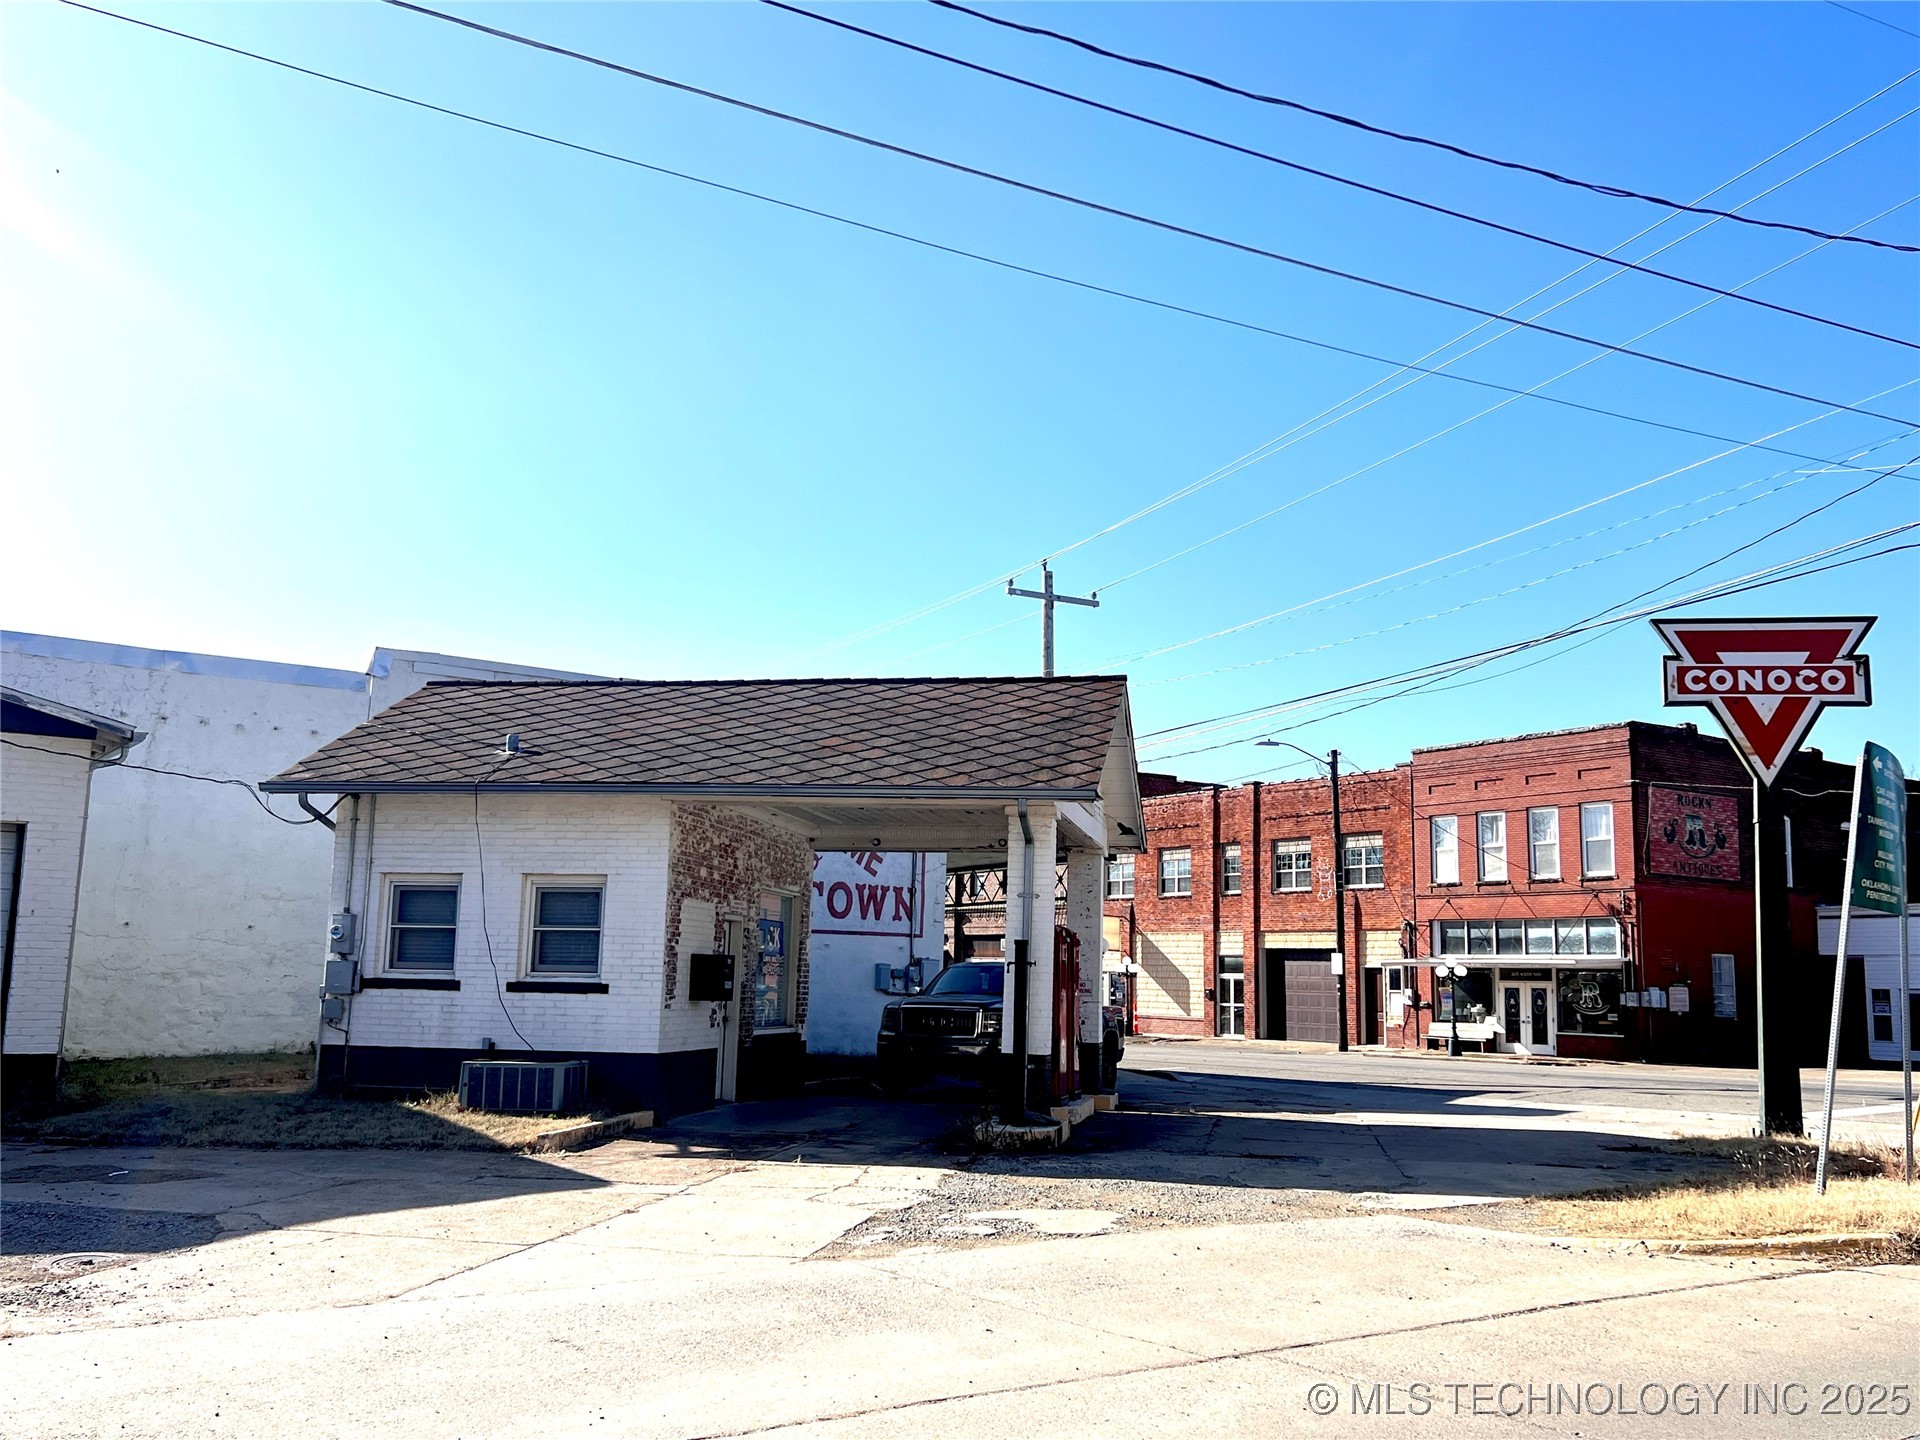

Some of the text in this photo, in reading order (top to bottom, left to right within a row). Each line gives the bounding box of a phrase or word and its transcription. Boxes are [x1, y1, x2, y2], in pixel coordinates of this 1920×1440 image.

[1684, 669, 1847, 692] CONOCO
[1673, 861, 1722, 875] ANTIQUES
[1861, 878, 1891, 891] OKLAHOMA
